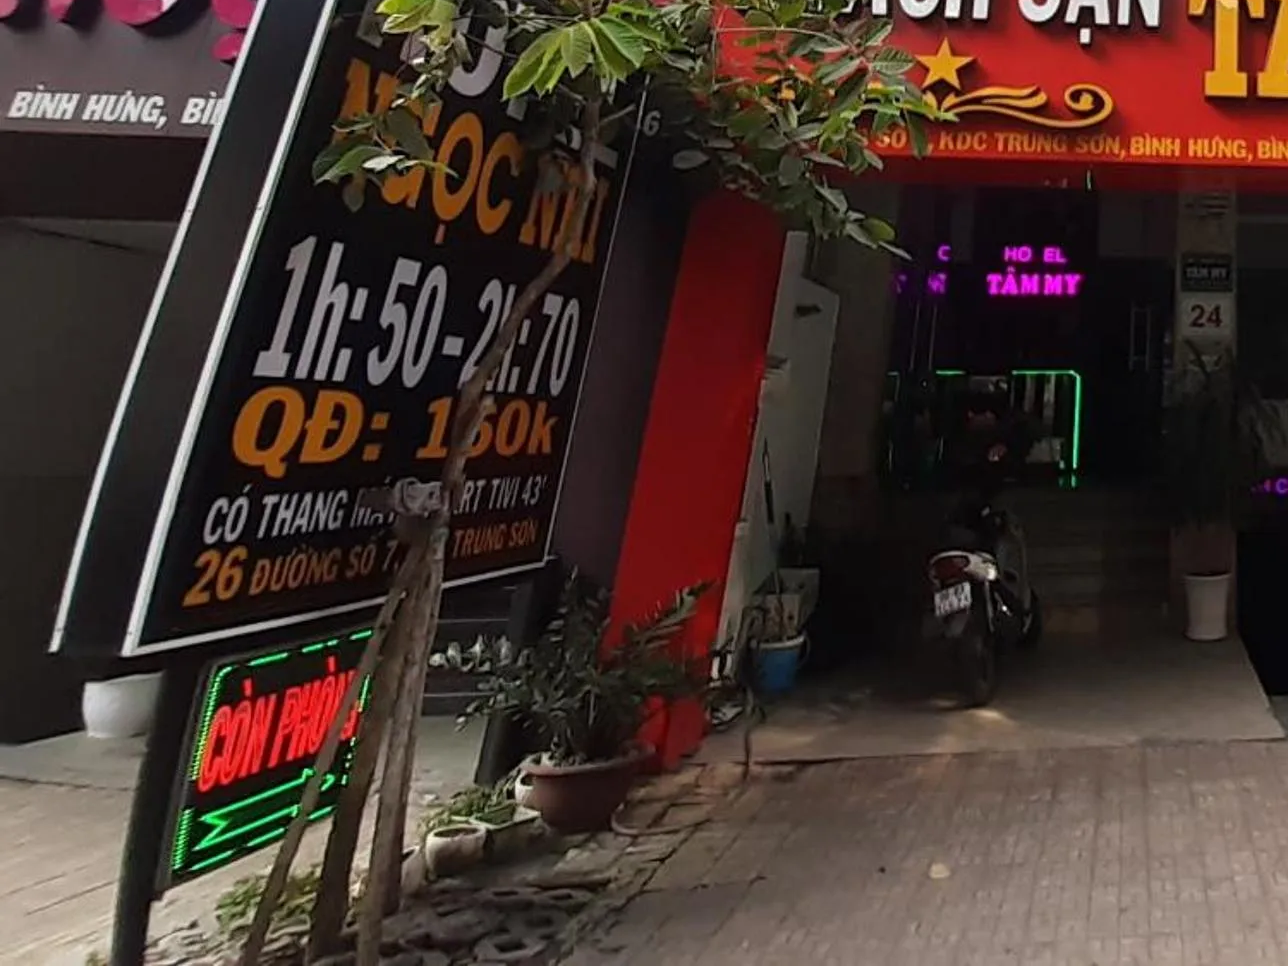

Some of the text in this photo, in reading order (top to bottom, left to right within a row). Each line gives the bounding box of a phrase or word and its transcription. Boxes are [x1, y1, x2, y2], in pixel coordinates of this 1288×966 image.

[8, 85, 80, 120] BÌNH
[82, 90, 168, 128] HƯNG,
[939, 131, 987, 151] KDC
[993, 133, 1067, 153] TRUNG
[1129, 133, 1180, 157] BÌNH
[1189, 304, 1222, 327] 24
[232, 386, 391, 479] QĐ:
[203, 484, 251, 545] CÓ
[256, 486, 349, 539] THANG
[182, 545, 248, 607] 26
[248, 542, 340, 596] ĐƯỜNG
[197, 677, 278, 793] CÒN
